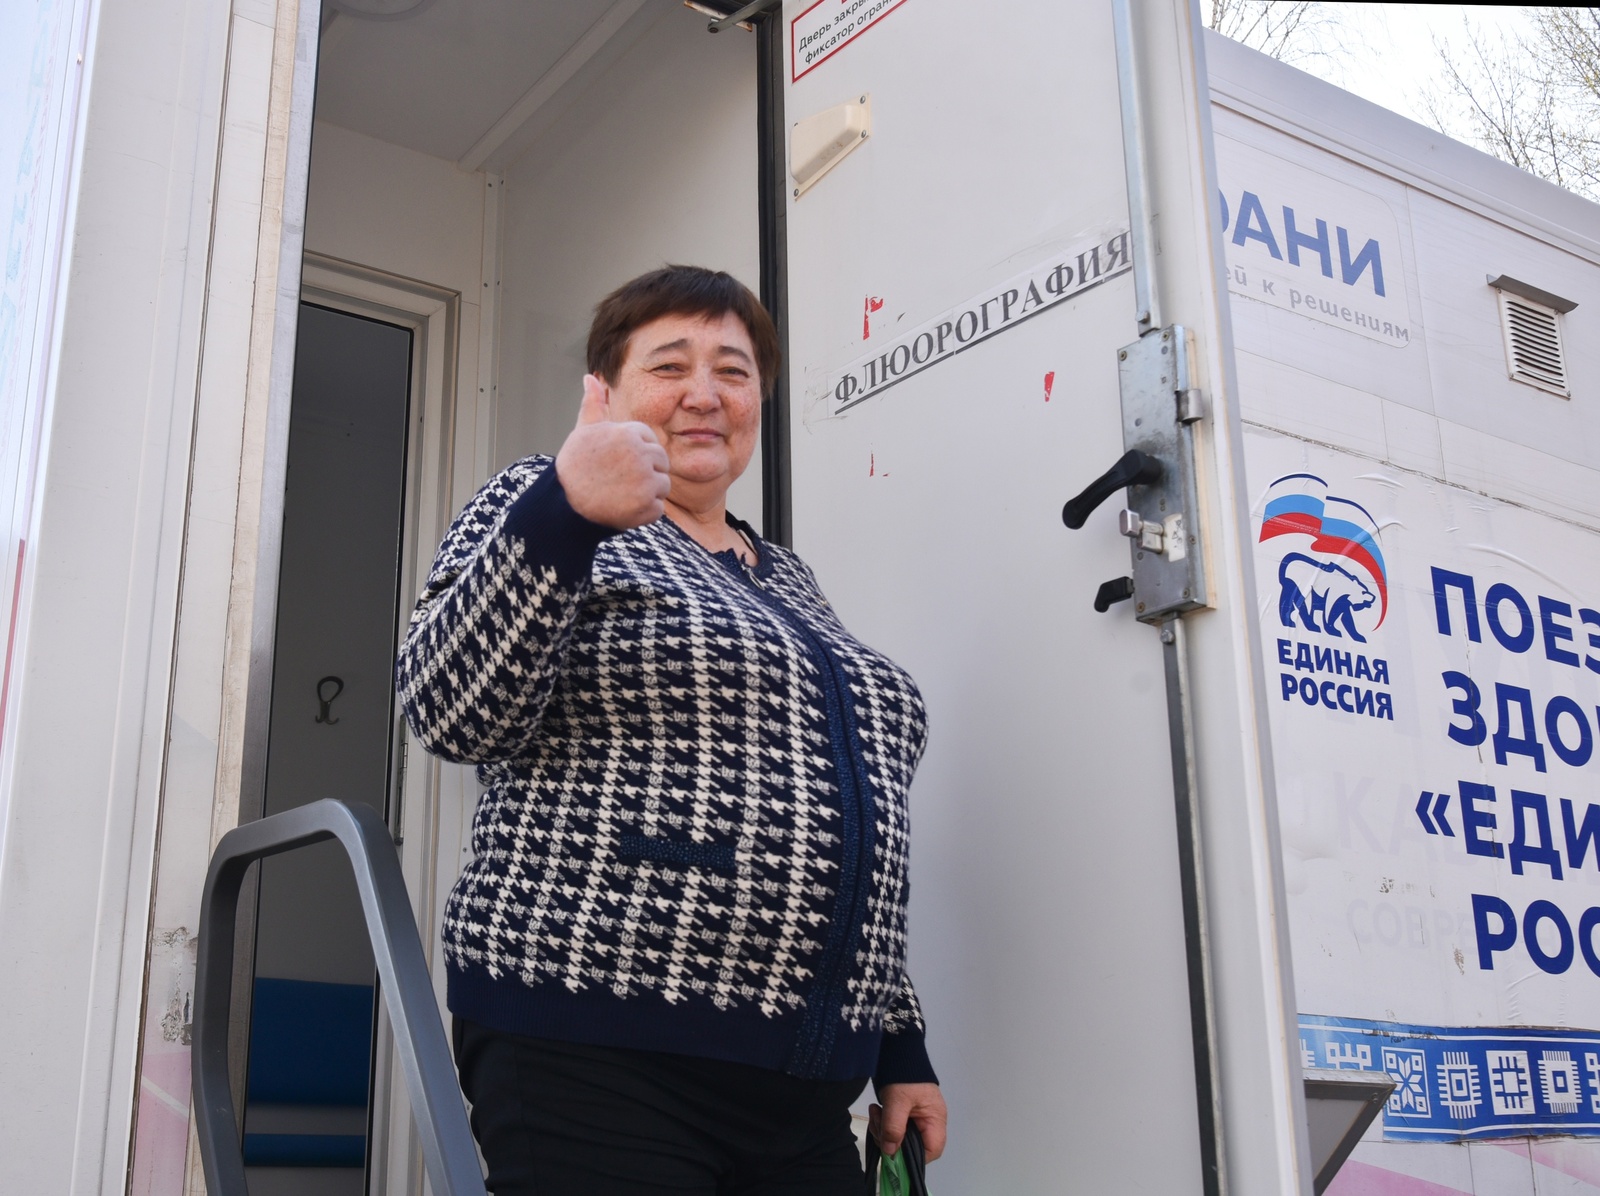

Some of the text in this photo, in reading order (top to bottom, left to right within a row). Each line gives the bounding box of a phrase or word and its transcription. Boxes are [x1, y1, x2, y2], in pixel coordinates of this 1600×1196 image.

[799, 0, 870, 52] Дверь закры
[805, 0, 892, 64] фиксатор огран
[1218, 188, 1386, 298] АНИ
[835, 230, 1131, 404] ФЛЮОРОГРАФИЯ
[1262, 279, 1276, 296] к
[1289, 287, 1409, 342] решениям
[1276, 638, 1390, 685] ЕДИНАЯ
[1280, 673, 1394, 721] РОССИЯ
[1441, 671, 1600, 774] ЗДО
